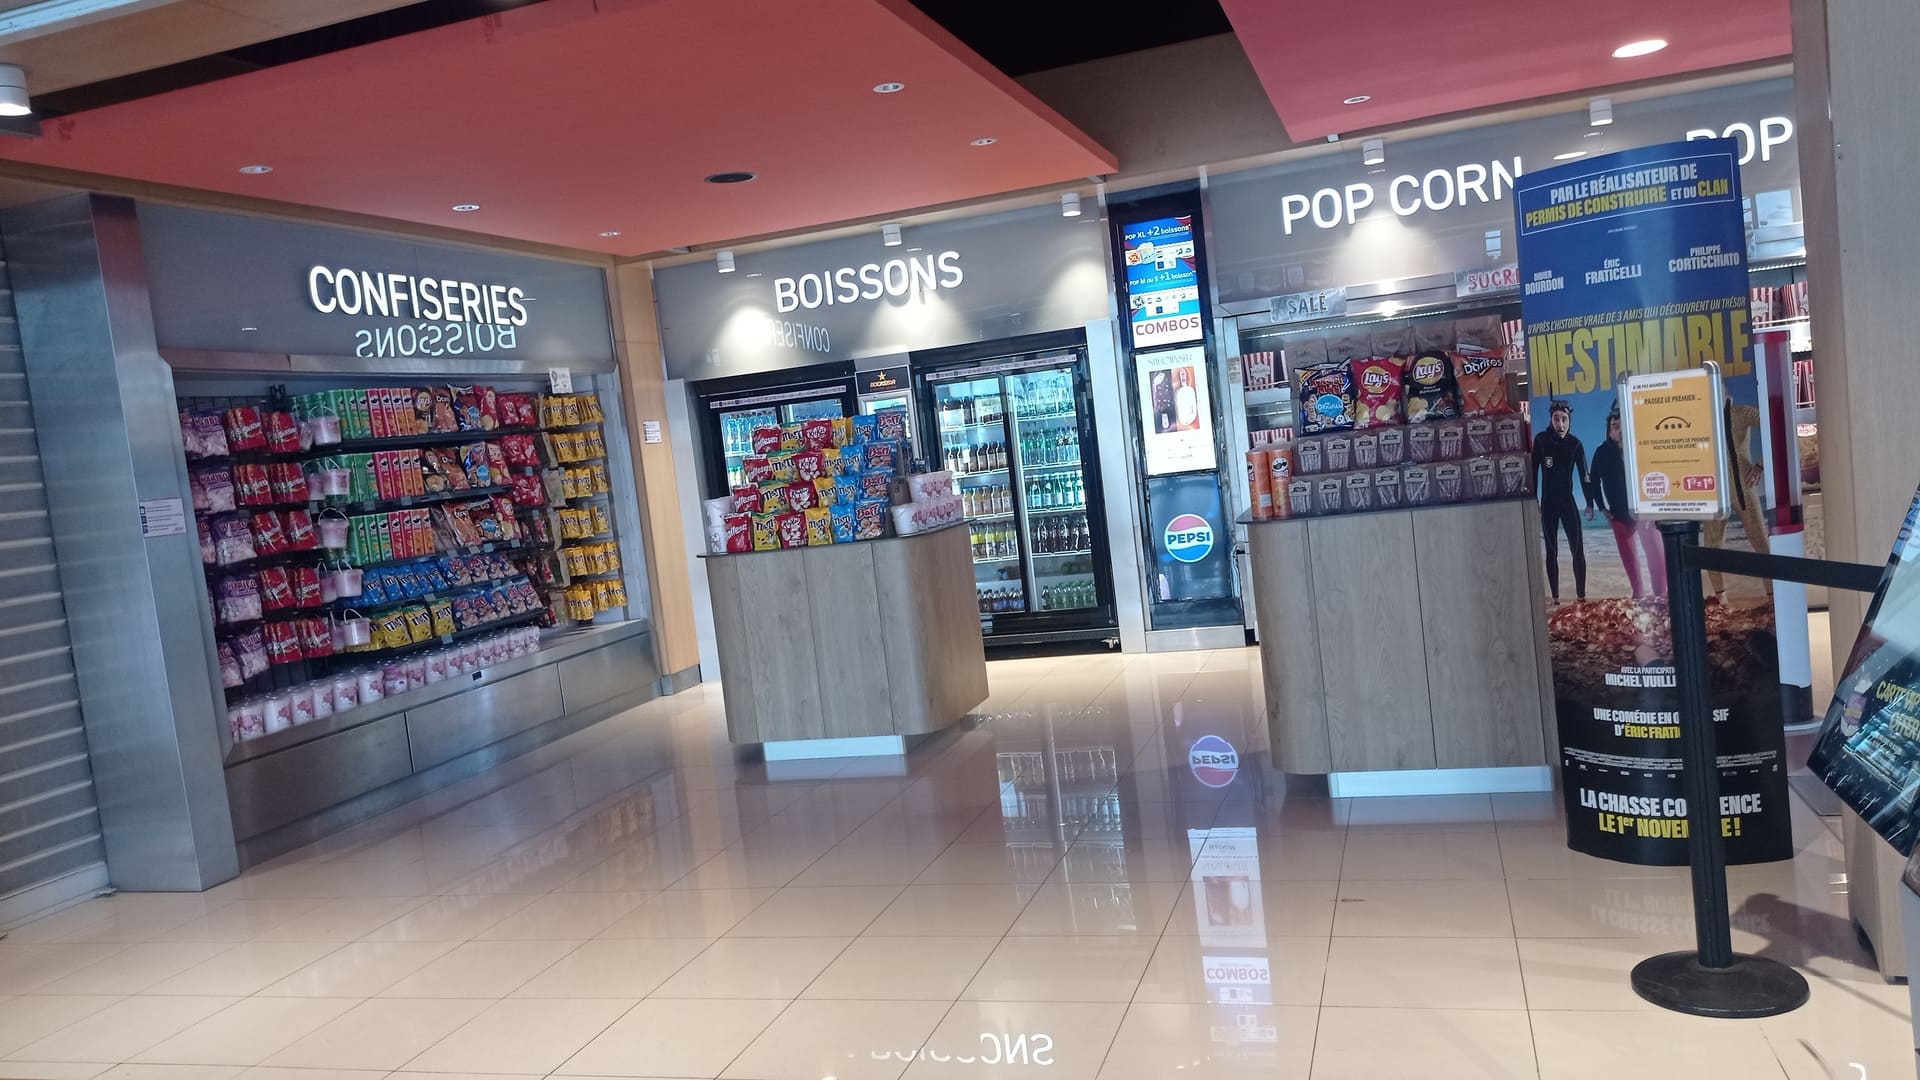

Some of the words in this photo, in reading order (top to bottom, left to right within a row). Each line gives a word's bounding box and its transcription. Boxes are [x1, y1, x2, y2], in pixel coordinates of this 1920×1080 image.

[1550, 188, 1573, 204] PAR
[1575, 184, 1589, 200] LE
[1589, 166, 1680, 197] RÉALISATEUR
[1681, 163, 1698, 180] DE
[1281, 182, 1375, 235] POP
[1389, 156, 1522, 216] CORN
[1525, 207, 1566, 228] PERMIS
[1567, 203, 1583, 219] DE
[1583, 186, 1667, 215] CONSTRUIRE
[1671, 188, 1683, 200] ET
[1683, 186, 1697, 199] DU
[1697, 179, 1729, 197] CLAN
[1603, 257, 1620, 270] ÉRIC
[1668, 252, 1741, 273] CORTICCHIATO
[773, 251, 964, 313] BOISSONS
[1584, 263, 1643, 286] FRATICELLI
[308, 264, 528, 327] CONFISERIES
[1525, 276, 1565, 296] BOURDON
[1287, 290, 1328, 316] SALÉ
[1622, 308, 1643, 321] AMIS
[1643, 306, 1659, 318] QUI
[1659, 300, 1711, 315] DÉCOUVRENT
[1135, 316, 1200, 336] COMBOS
[1528, 309, 1751, 397] INESTIMABLE
[1463, 358, 1504, 375] Doritos
[1166, 531, 1211, 546] PEPSI
[1605, 672, 1643, 688] MICHEL
[1593, 707, 1612, 721] UNE
[1612, 709, 1657, 724] COMÉDIE
[1657, 711, 1672, 724] EN
[1648, 726, 1680, 739] FRATI
[1580, 787, 1599, 809] LA
[1598, 791, 1661, 817] CHASSE
[1662, 793, 1762, 818] COENCE
[1598, 812, 1617, 834] LE
[1616, 815, 1635, 835] 1er
